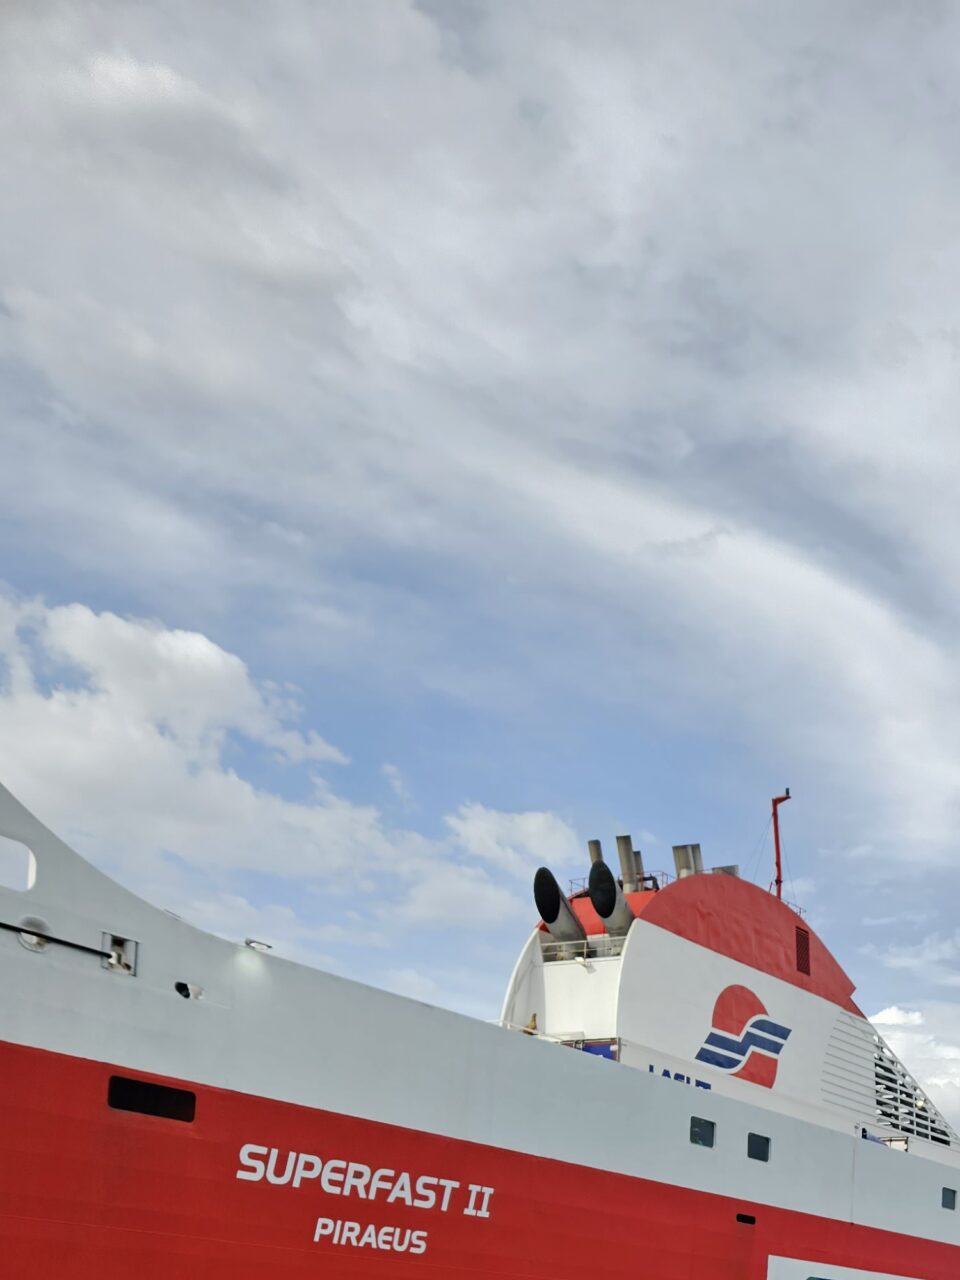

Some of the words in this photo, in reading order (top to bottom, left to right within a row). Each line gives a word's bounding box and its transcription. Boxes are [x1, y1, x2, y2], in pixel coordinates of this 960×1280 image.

[236, 1143, 460, 1212] SUPERFAST
[463, 1184, 495, 1218] II
[313, 1217, 428, 1254] PIRAEUS
